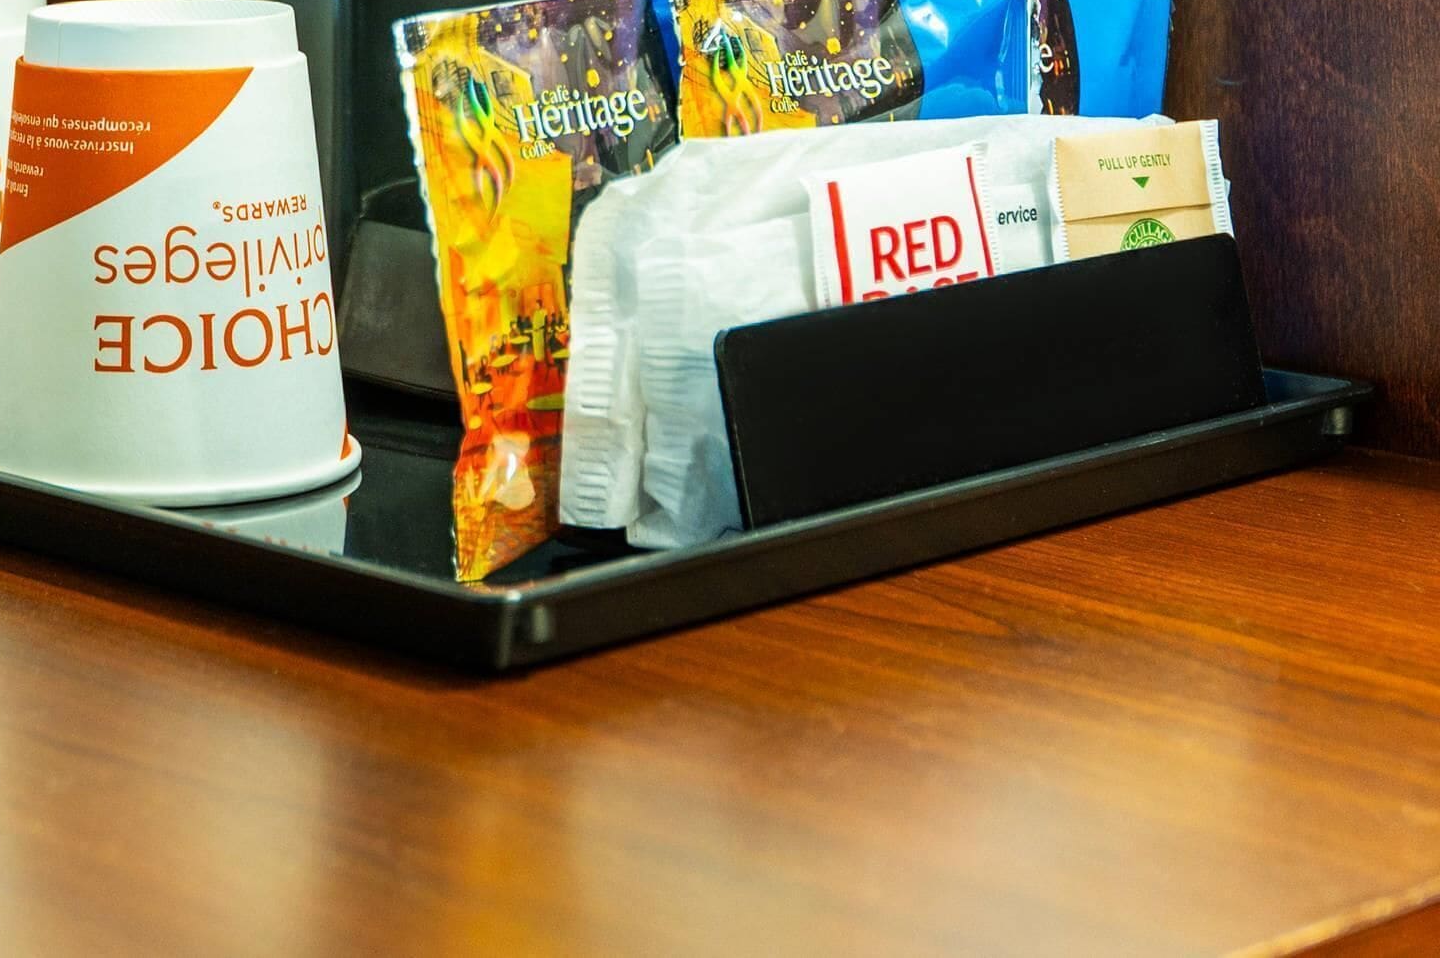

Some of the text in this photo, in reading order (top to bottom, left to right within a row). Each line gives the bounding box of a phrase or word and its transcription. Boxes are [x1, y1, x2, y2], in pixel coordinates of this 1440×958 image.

[541, 84, 570, 106] Café
[771, 97, 800, 114] Coffee
[42, 113, 59, 131] qui
[61, 117, 152, 136] récompenses
[44, 136, 135, 155] Inscrivez-vous
[522, 140, 557, 160] Coffee
[1098, 153, 1172, 171] PULL UP GENTLY
[997, 205, 1038, 225] ervice
[94, 204, 326, 298] privileges
[870, 215, 963, 283] RED
[94, 292, 333, 373] CHOICE
